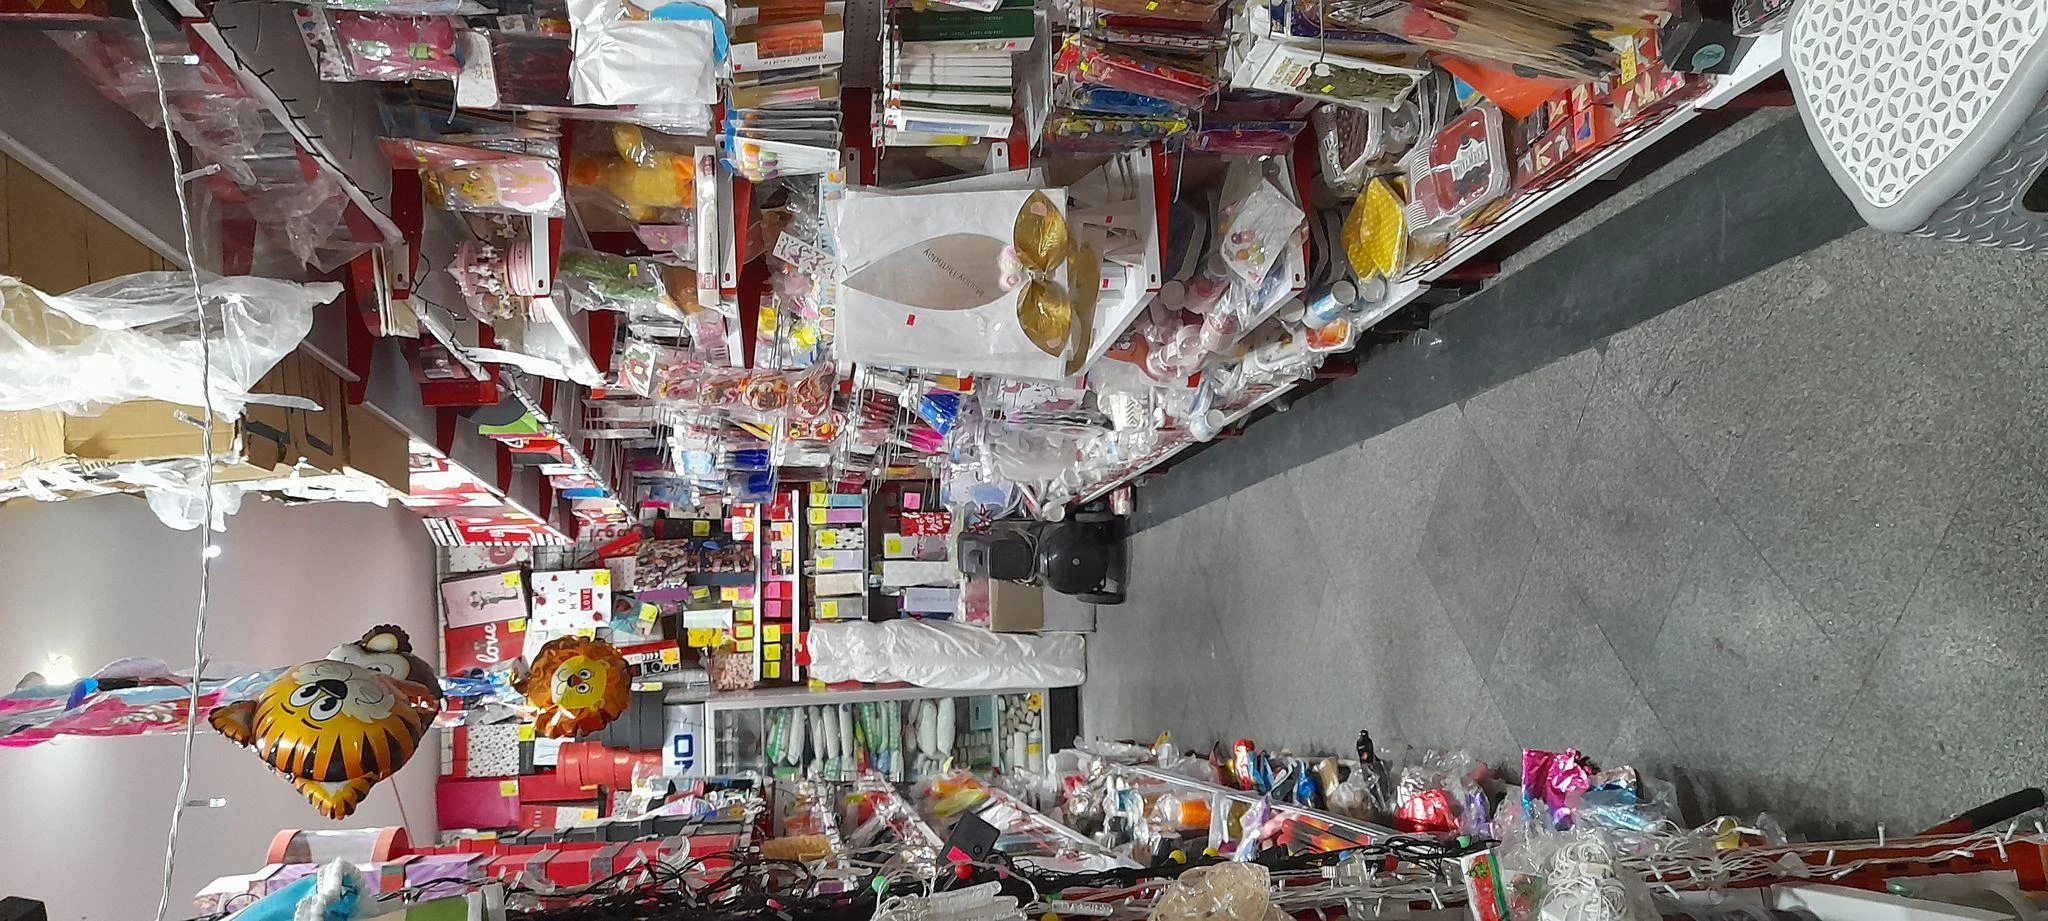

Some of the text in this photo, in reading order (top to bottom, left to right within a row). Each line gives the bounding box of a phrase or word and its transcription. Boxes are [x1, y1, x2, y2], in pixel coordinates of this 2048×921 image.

[922, 248, 984, 298] Happy Birthday
[558, 586, 567, 614] FOR
[569, 592, 578, 610] MY
[582, 588, 592, 610] LOVE
[475, 623, 500, 663] love
